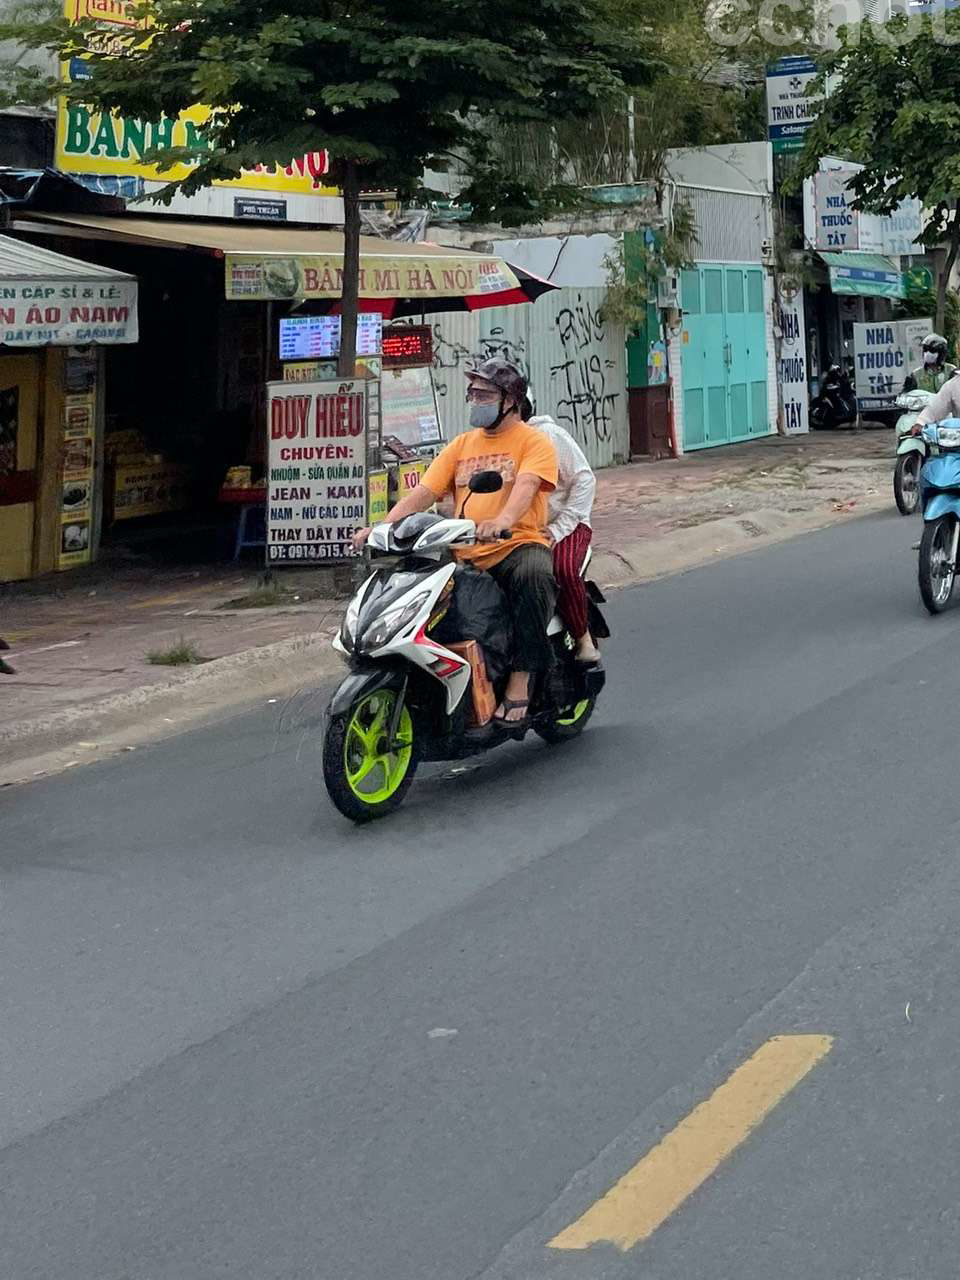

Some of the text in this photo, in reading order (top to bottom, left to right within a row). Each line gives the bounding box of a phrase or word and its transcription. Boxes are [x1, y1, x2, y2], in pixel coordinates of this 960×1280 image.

[826, 194, 847, 208] NHÀ
[821, 209, 853, 227] THUỐC
[827, 231, 847, 245] TÂY
[407, 264, 436, 291] HÀ
[25, 304, 61, 324] ÁO
[70, 307, 129, 323] NAM
[866, 324, 894, 345] NHÀ
[857, 342, 904, 370] THUỐC
[868, 372, 894, 394] TÂY
[271, 394, 312, 440] DUY
[785, 397, 802, 428] TÂY
[280, 444, 354, 461] CHUYÊN:
[352, 463, 364, 479] ÁO
[271, 487, 311, 501] JEAN
[327, 485, 363, 499] KAKI
[270, 507, 293, 521] NAM
[342, 505, 364, 521] LOẠI
[270, 528, 302, 541] THAY
